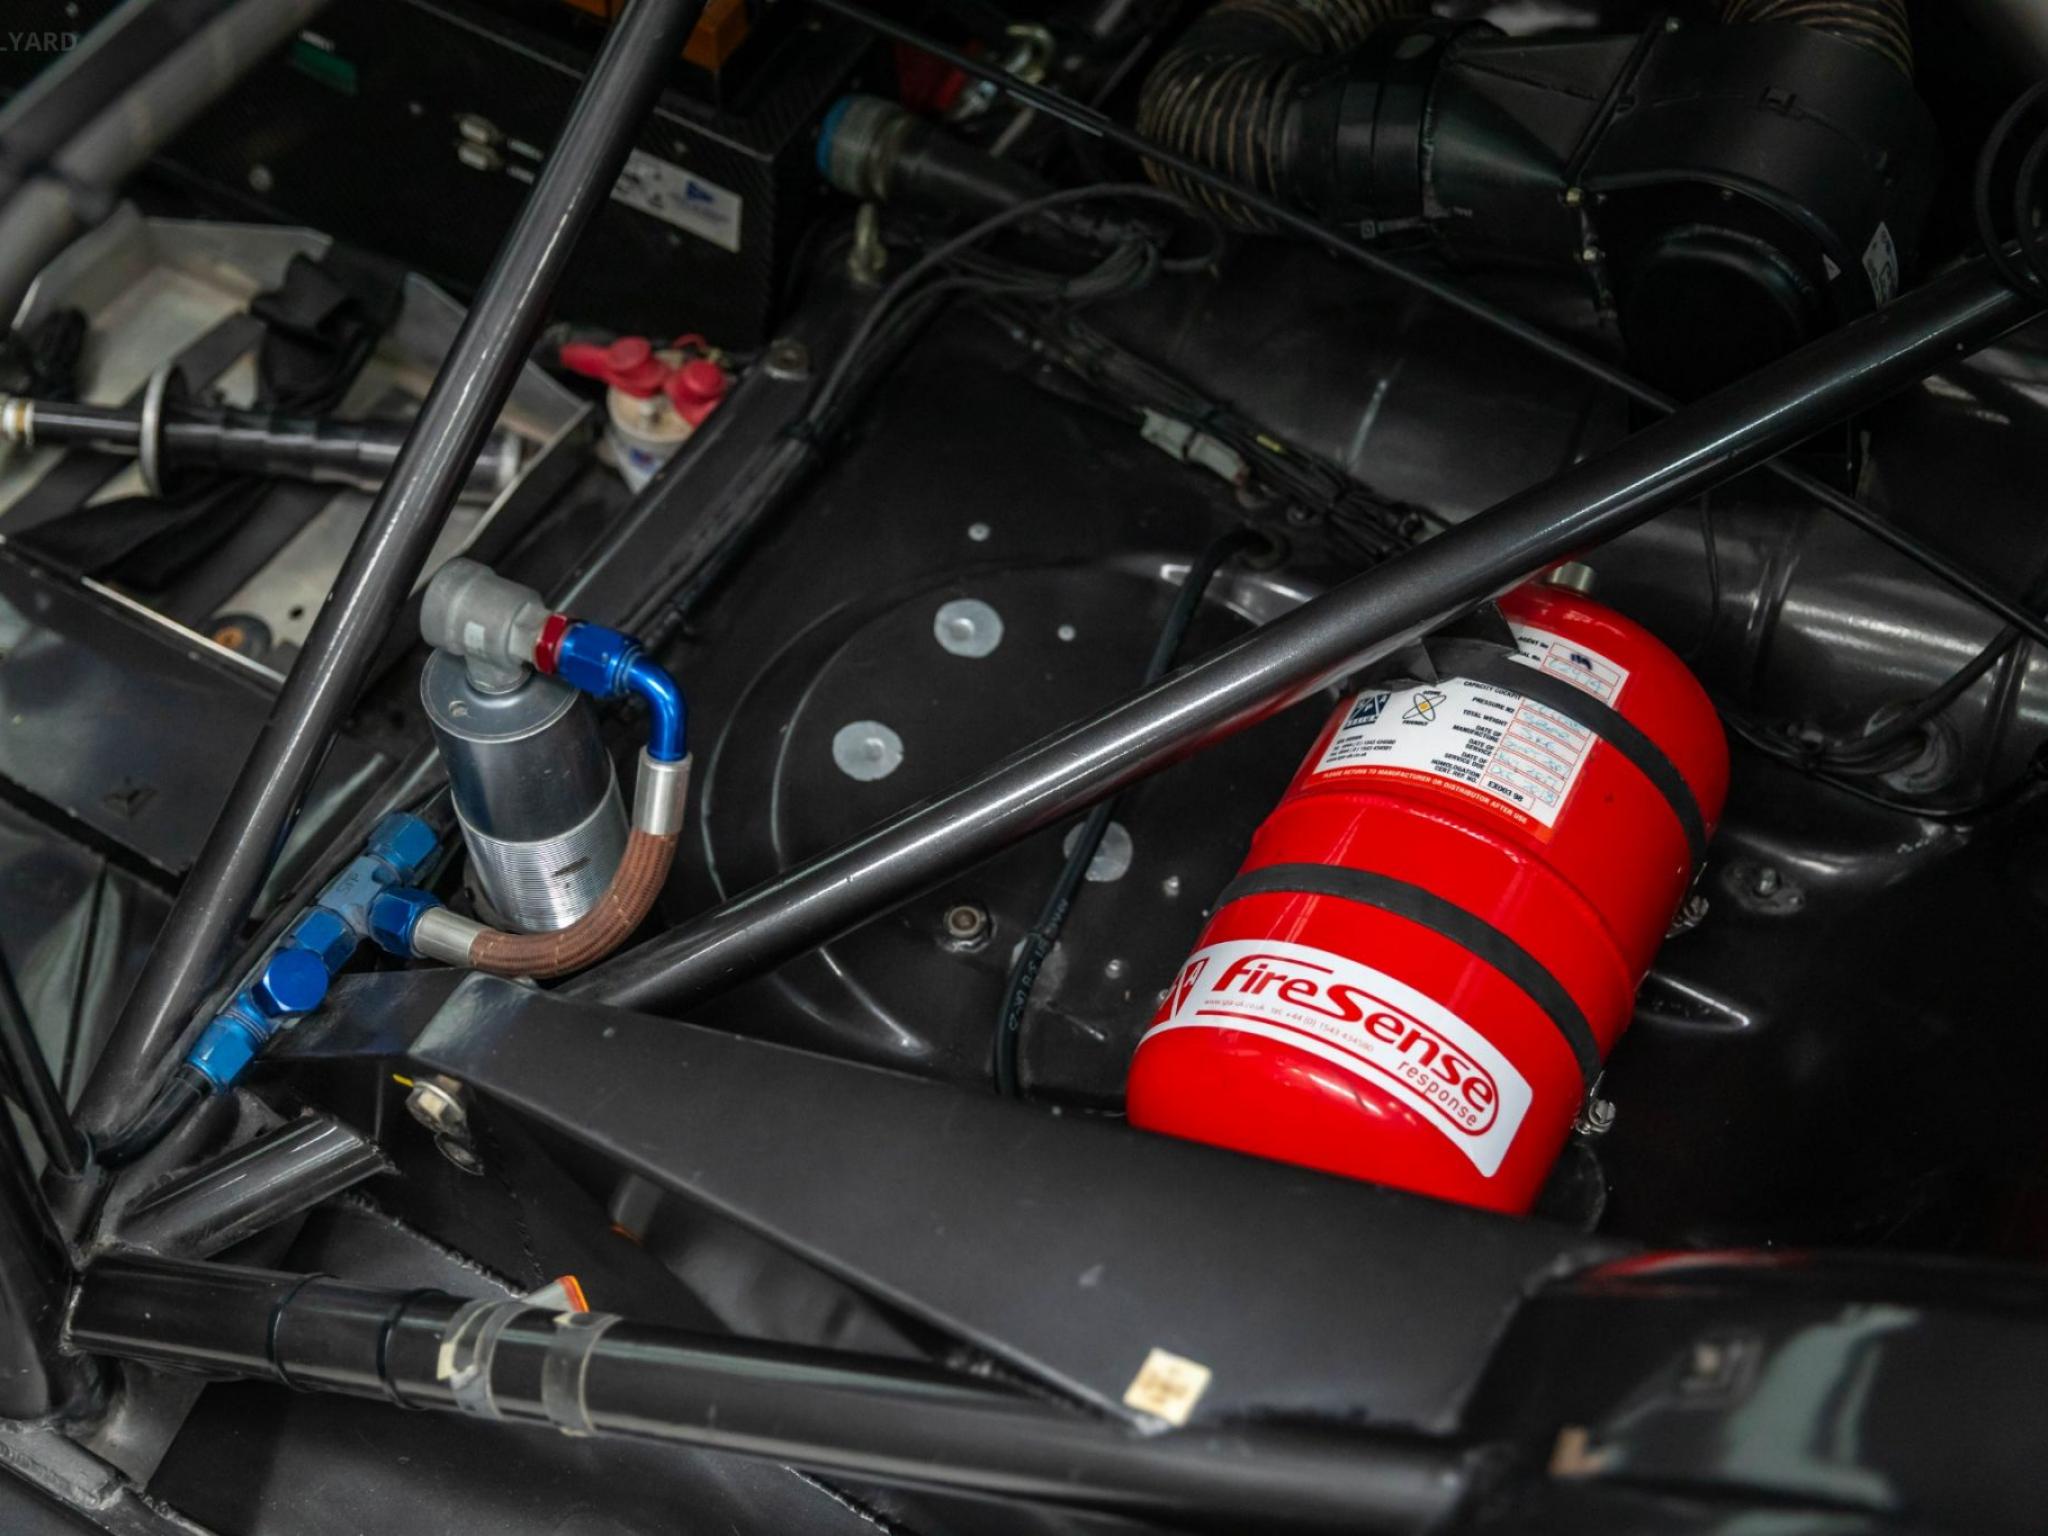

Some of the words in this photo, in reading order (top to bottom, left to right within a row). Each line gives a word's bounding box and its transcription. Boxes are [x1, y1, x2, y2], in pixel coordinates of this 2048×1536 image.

[1472, 696, 1505, 711] PRESSURE
[1463, 709, 1482, 718] TOTAL
[1482, 714, 1508, 726] WEIGHT
[1475, 724, 1492, 734] DATE
[1468, 737, 1486, 748] DATE
[1461, 751, 1479, 760] DATE
[1343, 768, 1367, 776] RETURN
[1377, 769, 1431, 783] MANUFACTURER
[1432, 774, 1443, 785] OR
[1443, 776, 1490, 806] DISTRIBUTOR
[1490, 799, 1514, 818] AFTER
[1514, 811, 1529, 825] USE
[1396, 1059, 1478, 1127] response
